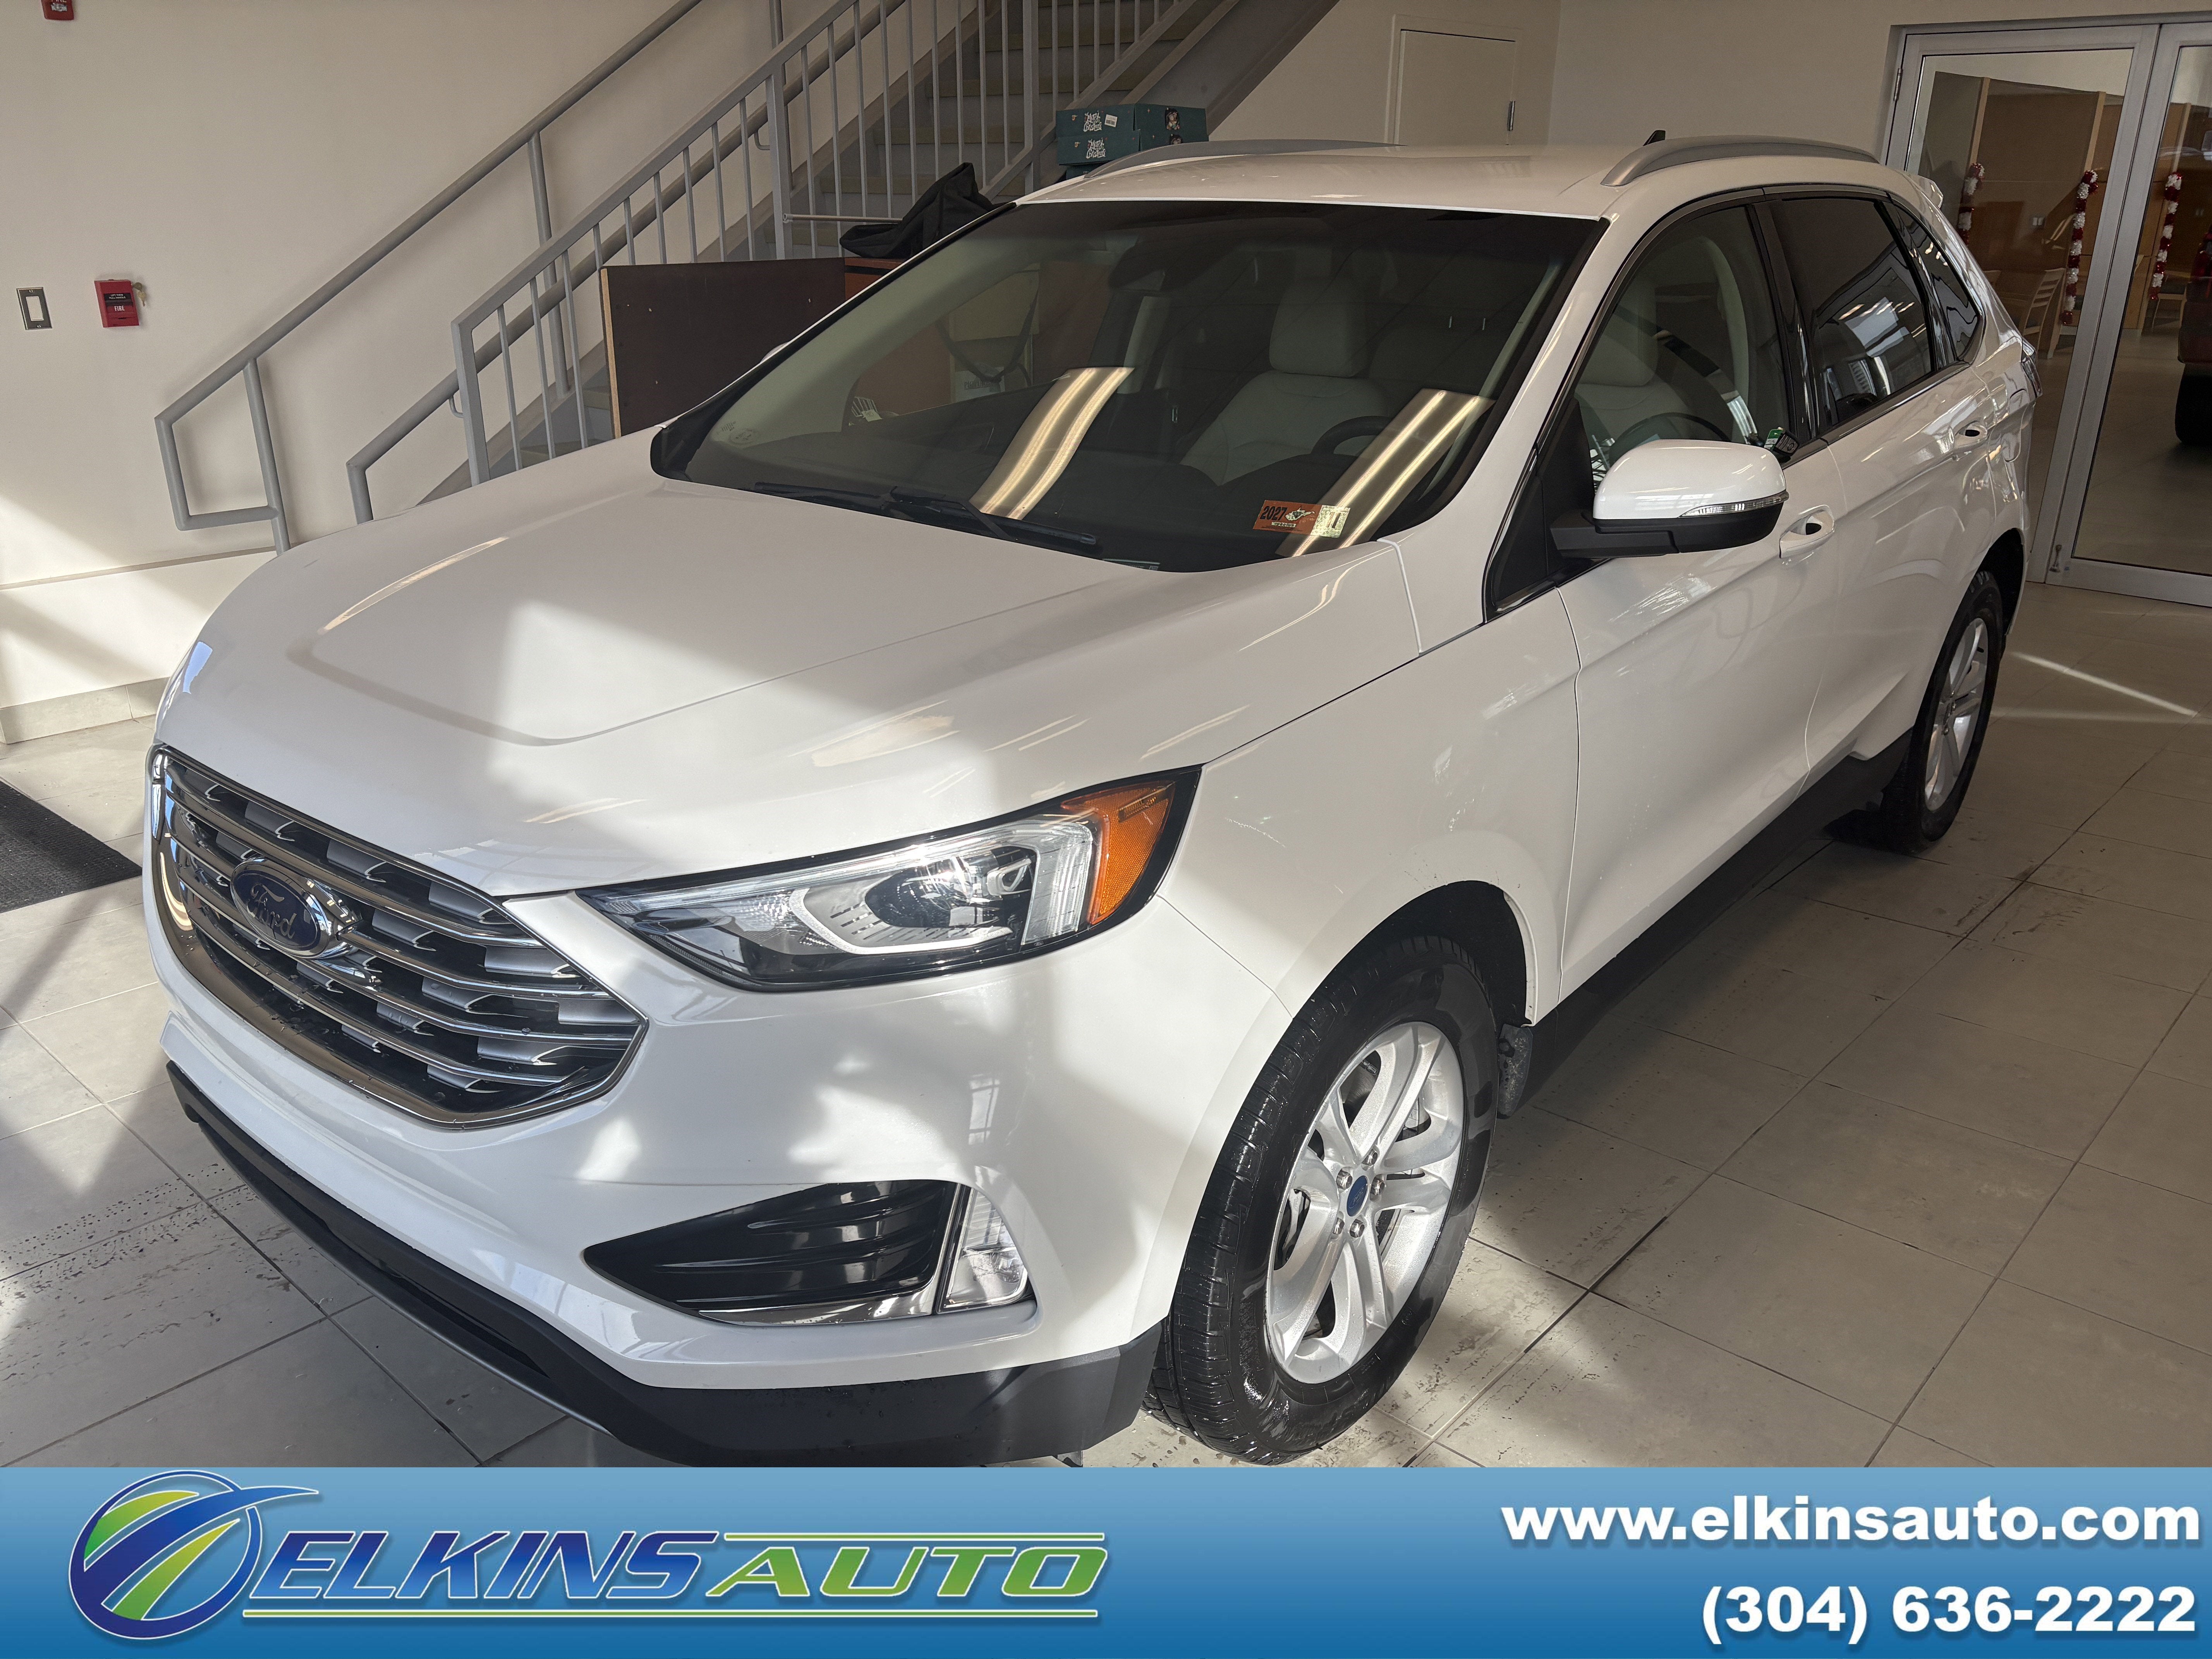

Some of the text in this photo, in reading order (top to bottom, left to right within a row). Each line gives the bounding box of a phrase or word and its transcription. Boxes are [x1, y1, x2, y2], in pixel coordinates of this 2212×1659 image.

[1085, 110, 1101, 124] Merry
[1088, 137, 1104, 151] Merry
[1259, 506, 1288, 521] 2027
[246, 883, 297, 939] Ford
